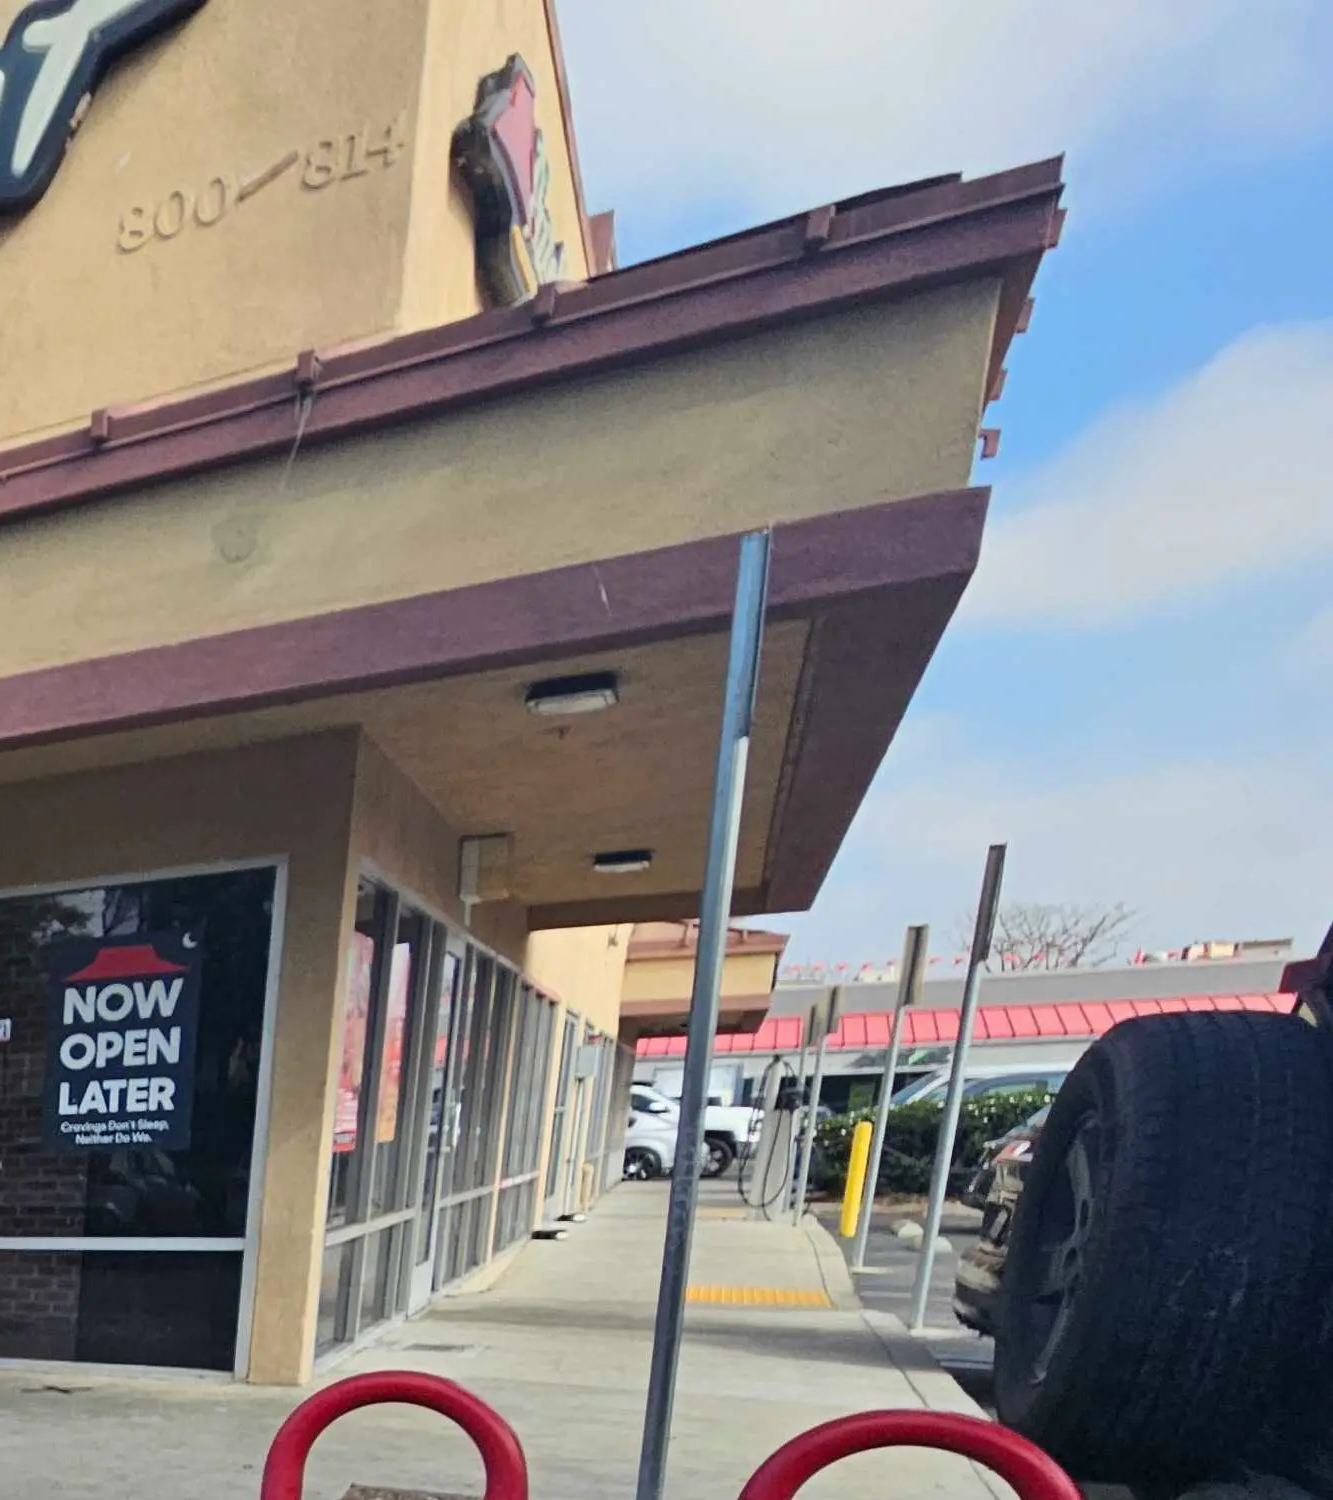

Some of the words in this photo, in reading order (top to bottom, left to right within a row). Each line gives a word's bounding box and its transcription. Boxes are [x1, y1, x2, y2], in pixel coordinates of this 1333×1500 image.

[63, 976, 184, 1025] NOW
[59, 1026, 181, 1070] OPEN
[58, 1077, 176, 1115] LATER
[60, 1121, 107, 1134] Cravings
[108, 1119, 136, 1131] Don't
[75, 1133, 113, 1144] Neither
[115, 1132, 131, 1144] Do
